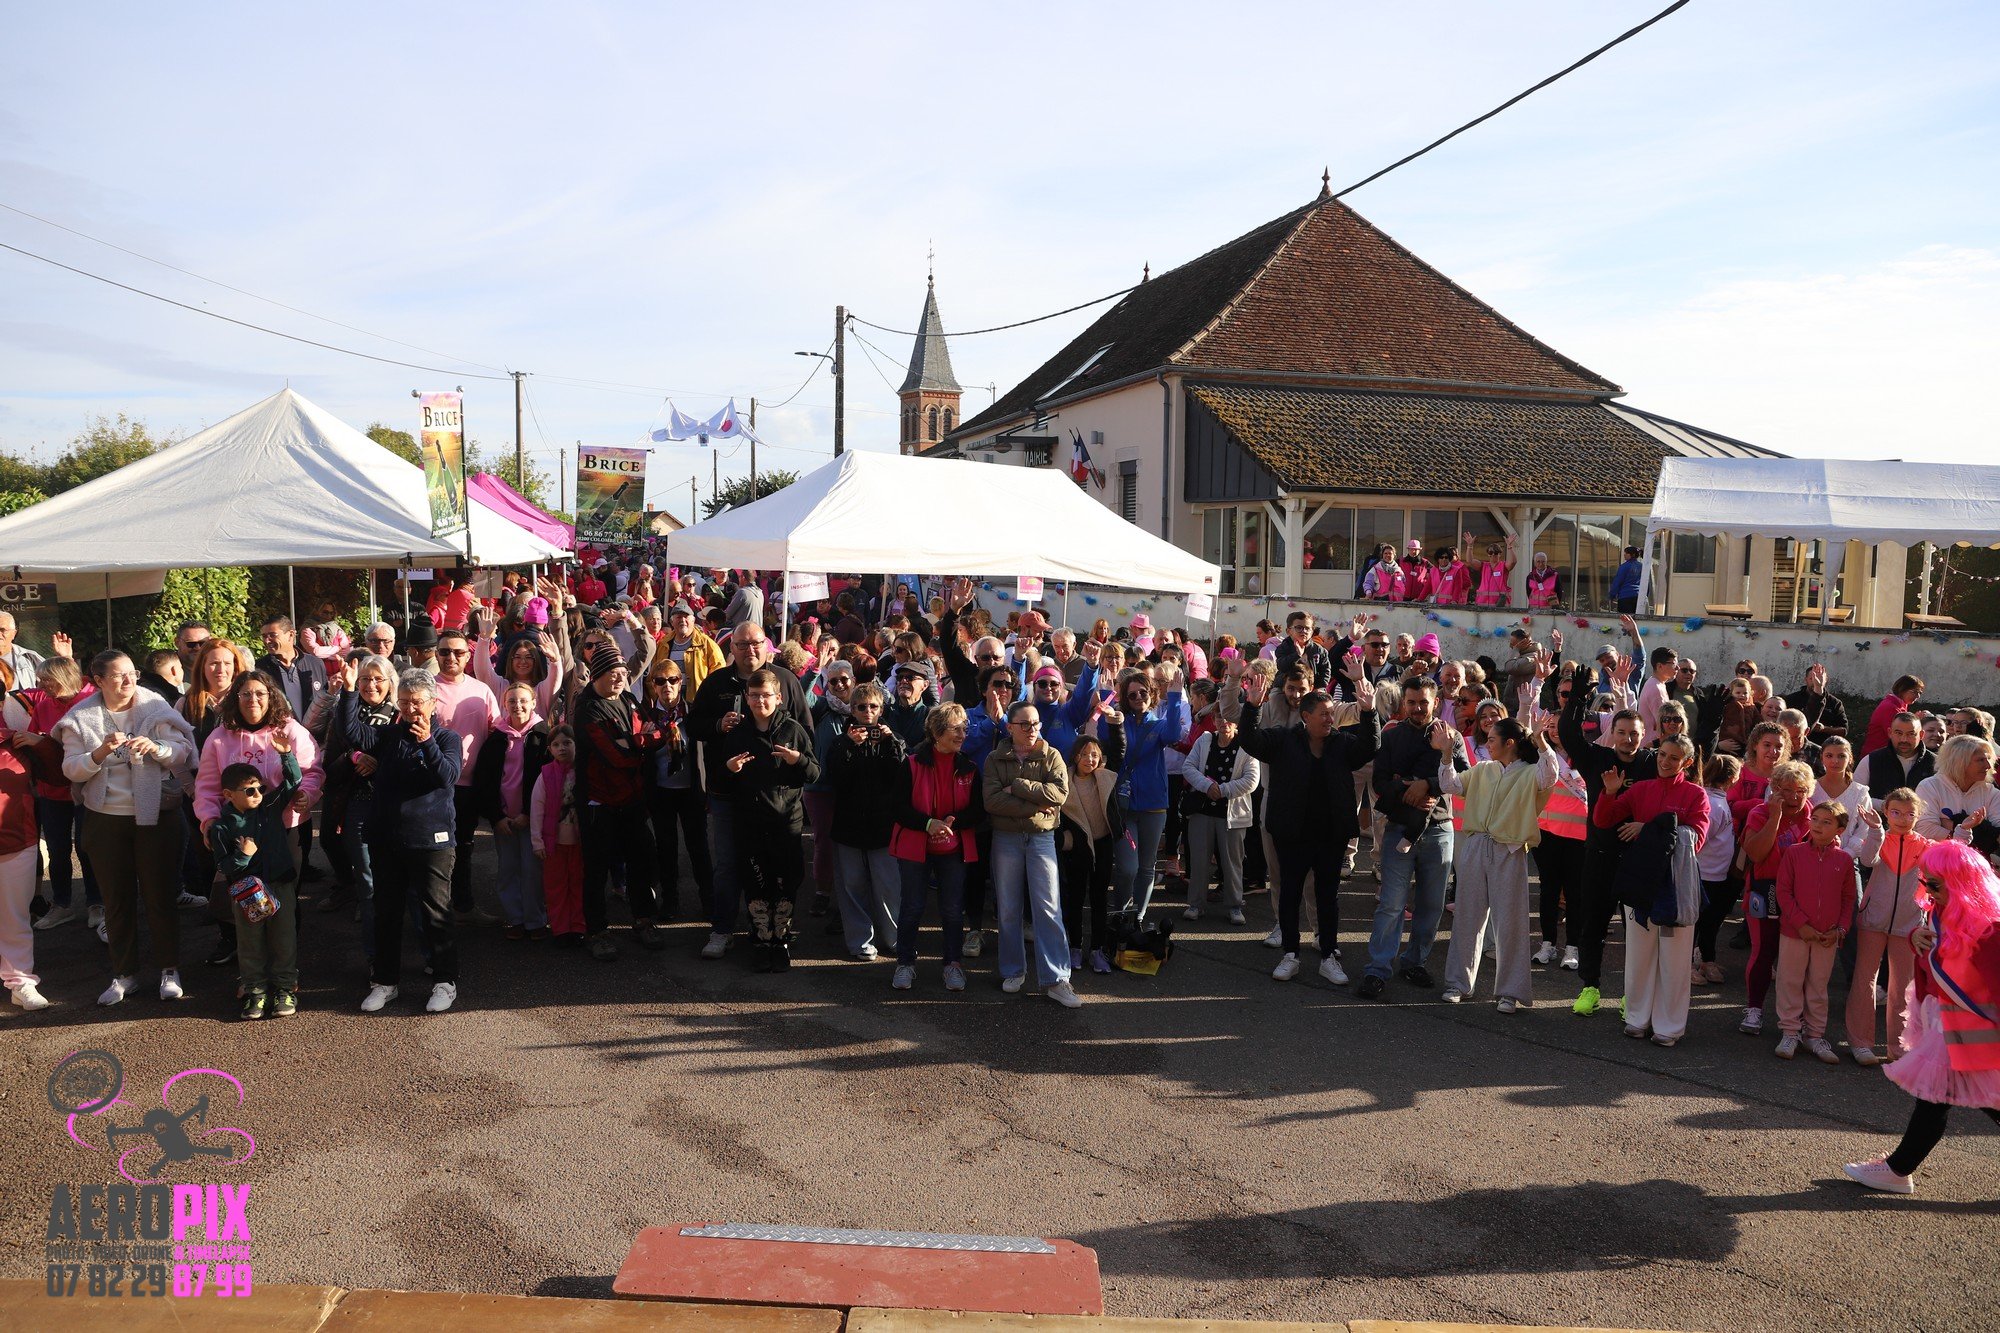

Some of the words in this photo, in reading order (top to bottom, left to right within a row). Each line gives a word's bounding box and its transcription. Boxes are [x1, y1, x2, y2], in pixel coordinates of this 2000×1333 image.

[423, 406, 458, 427] BRICE
[584, 454, 640, 472] BRICE
[791, 581, 825, 589] INSCRIPTIONS
